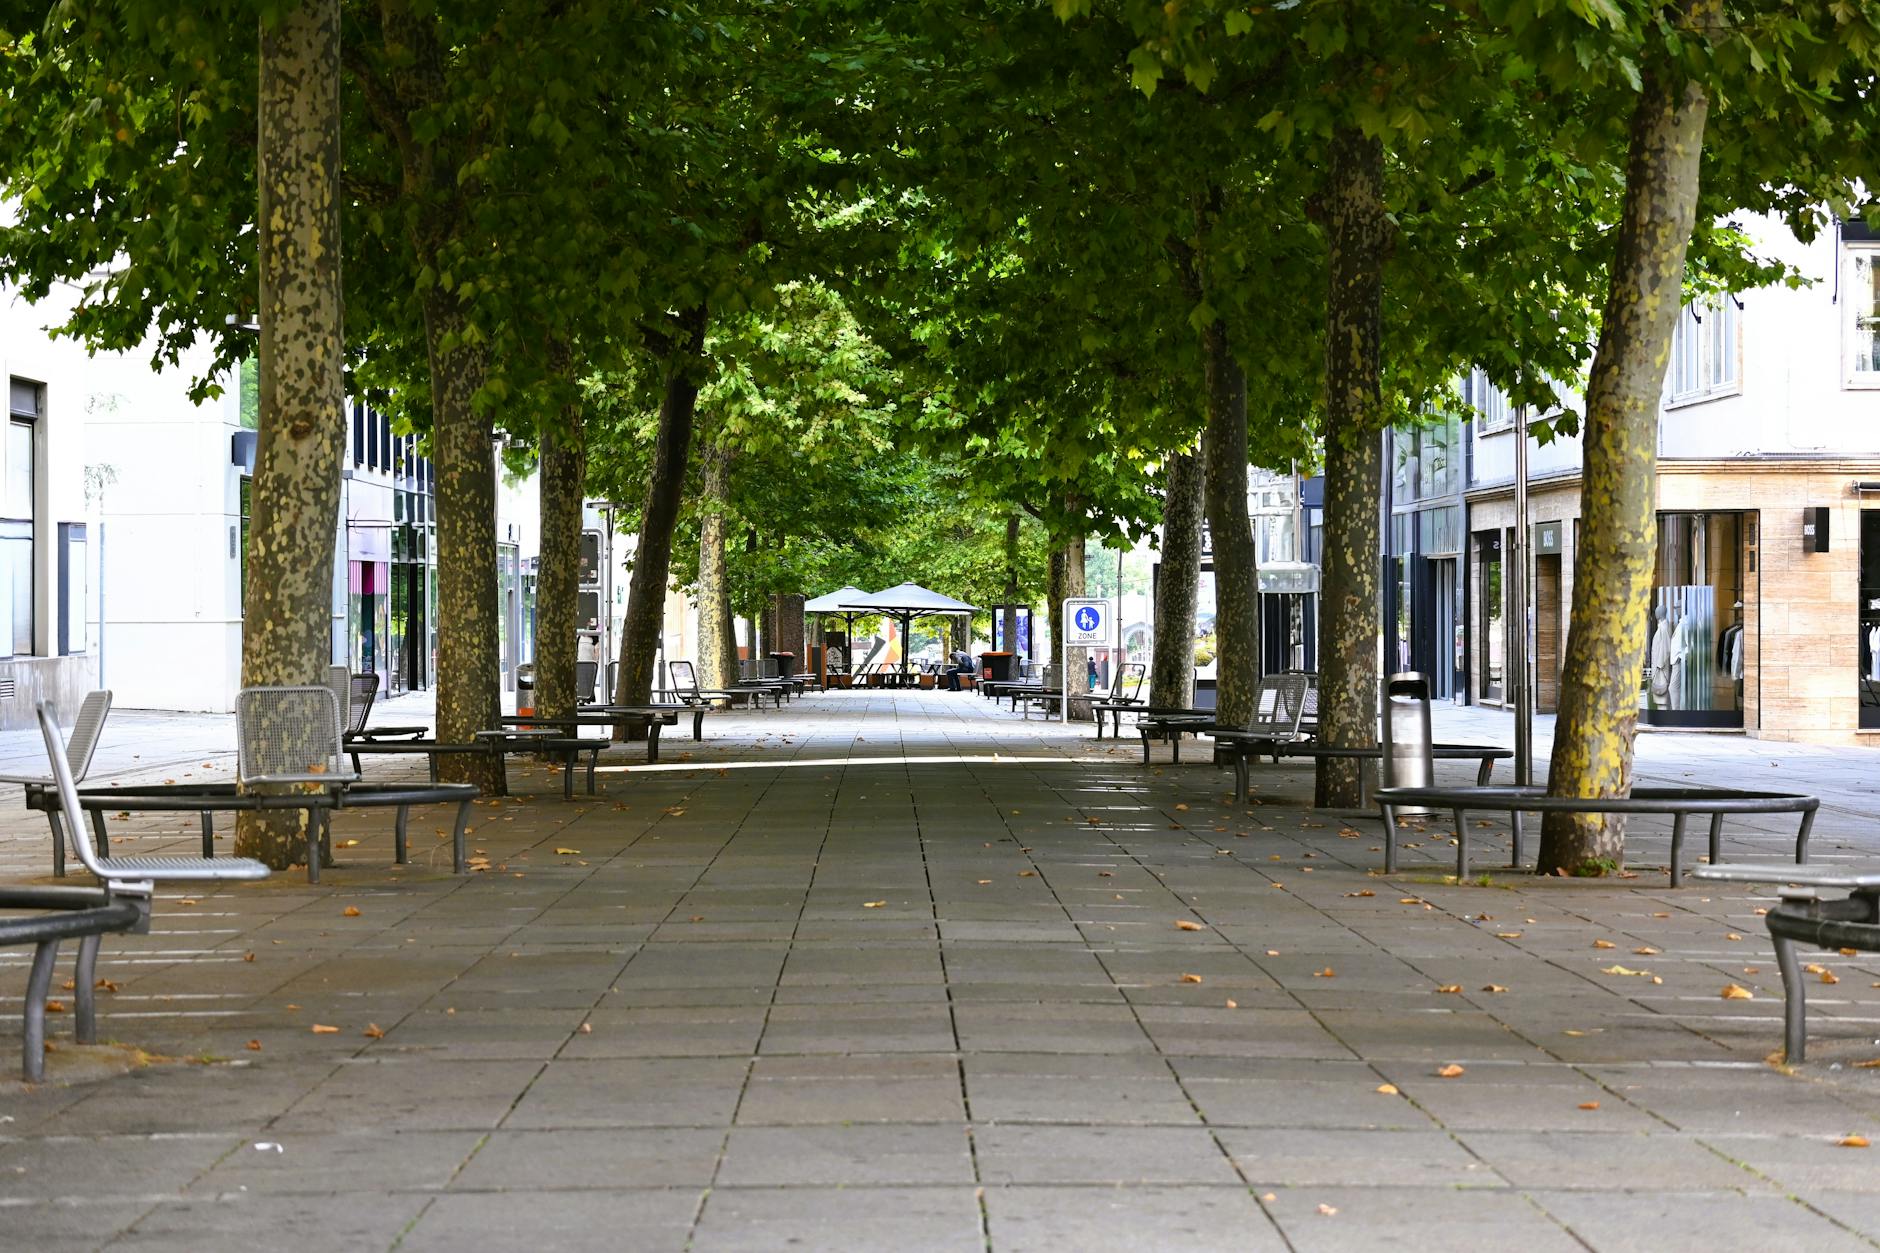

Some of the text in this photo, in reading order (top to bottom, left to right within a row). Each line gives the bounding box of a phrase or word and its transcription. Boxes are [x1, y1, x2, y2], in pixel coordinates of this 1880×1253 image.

[1804, 524, 1815, 536] BOSS
[1543, 529, 1554, 547] BOSS
[1078, 632, 1097, 640] ZONE
